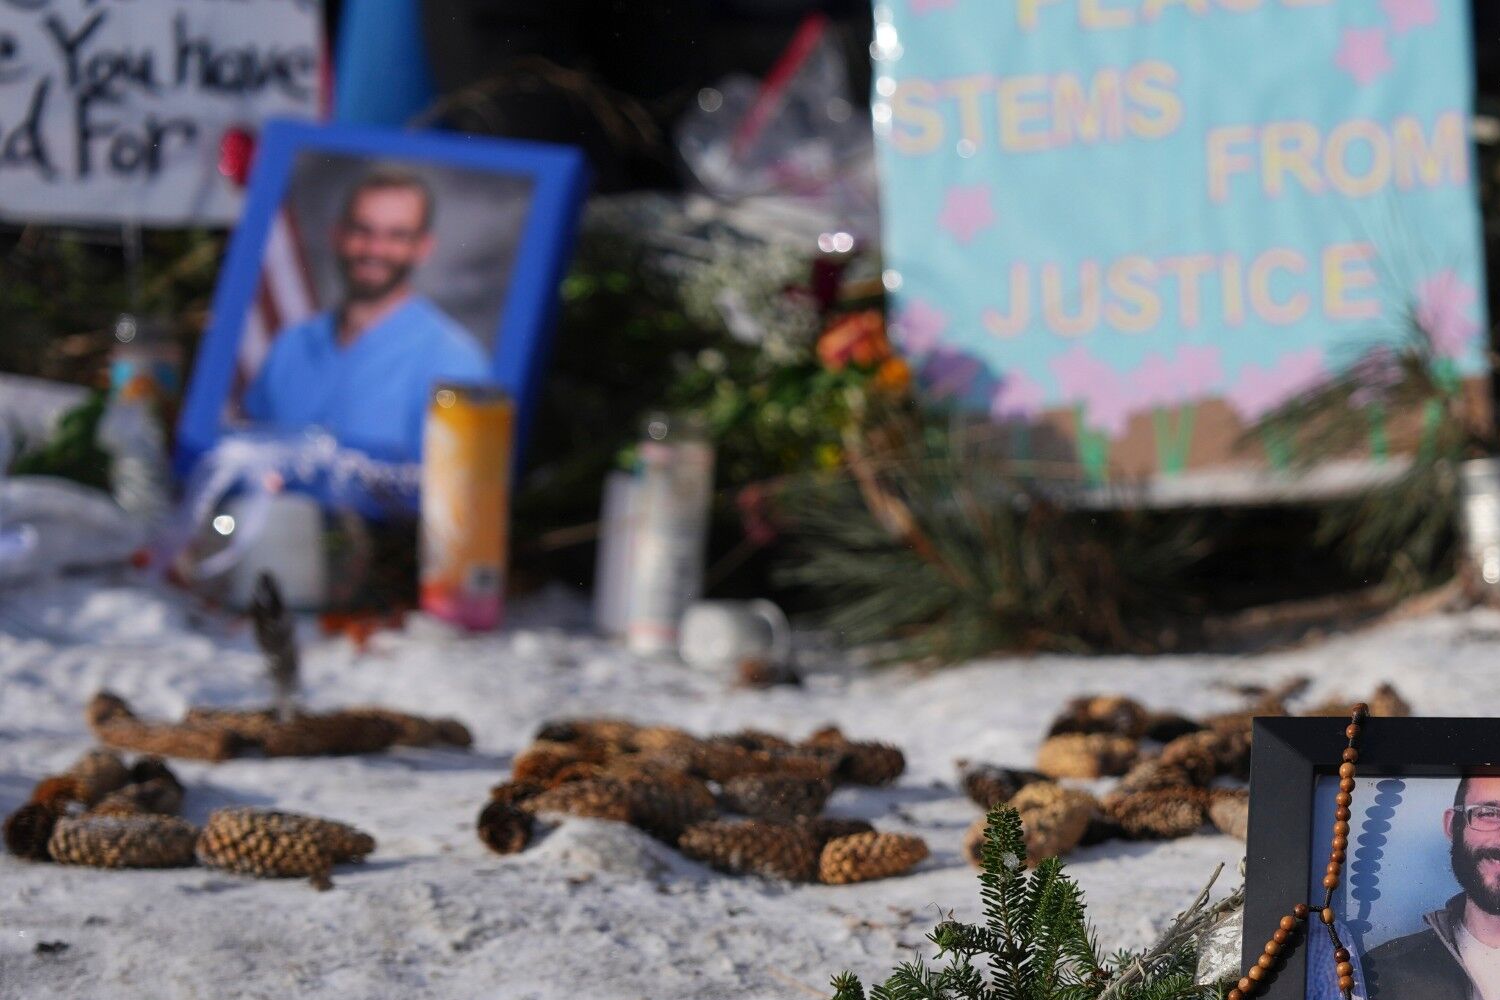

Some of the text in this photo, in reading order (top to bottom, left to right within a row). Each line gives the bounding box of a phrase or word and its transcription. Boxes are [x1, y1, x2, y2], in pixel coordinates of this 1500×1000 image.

[76, 80, 199, 182] For
[889, 59, 1185, 157] STEMS
[1205, 110, 1470, 203] FROM
[982, 240, 1382, 338] JUSTICE
